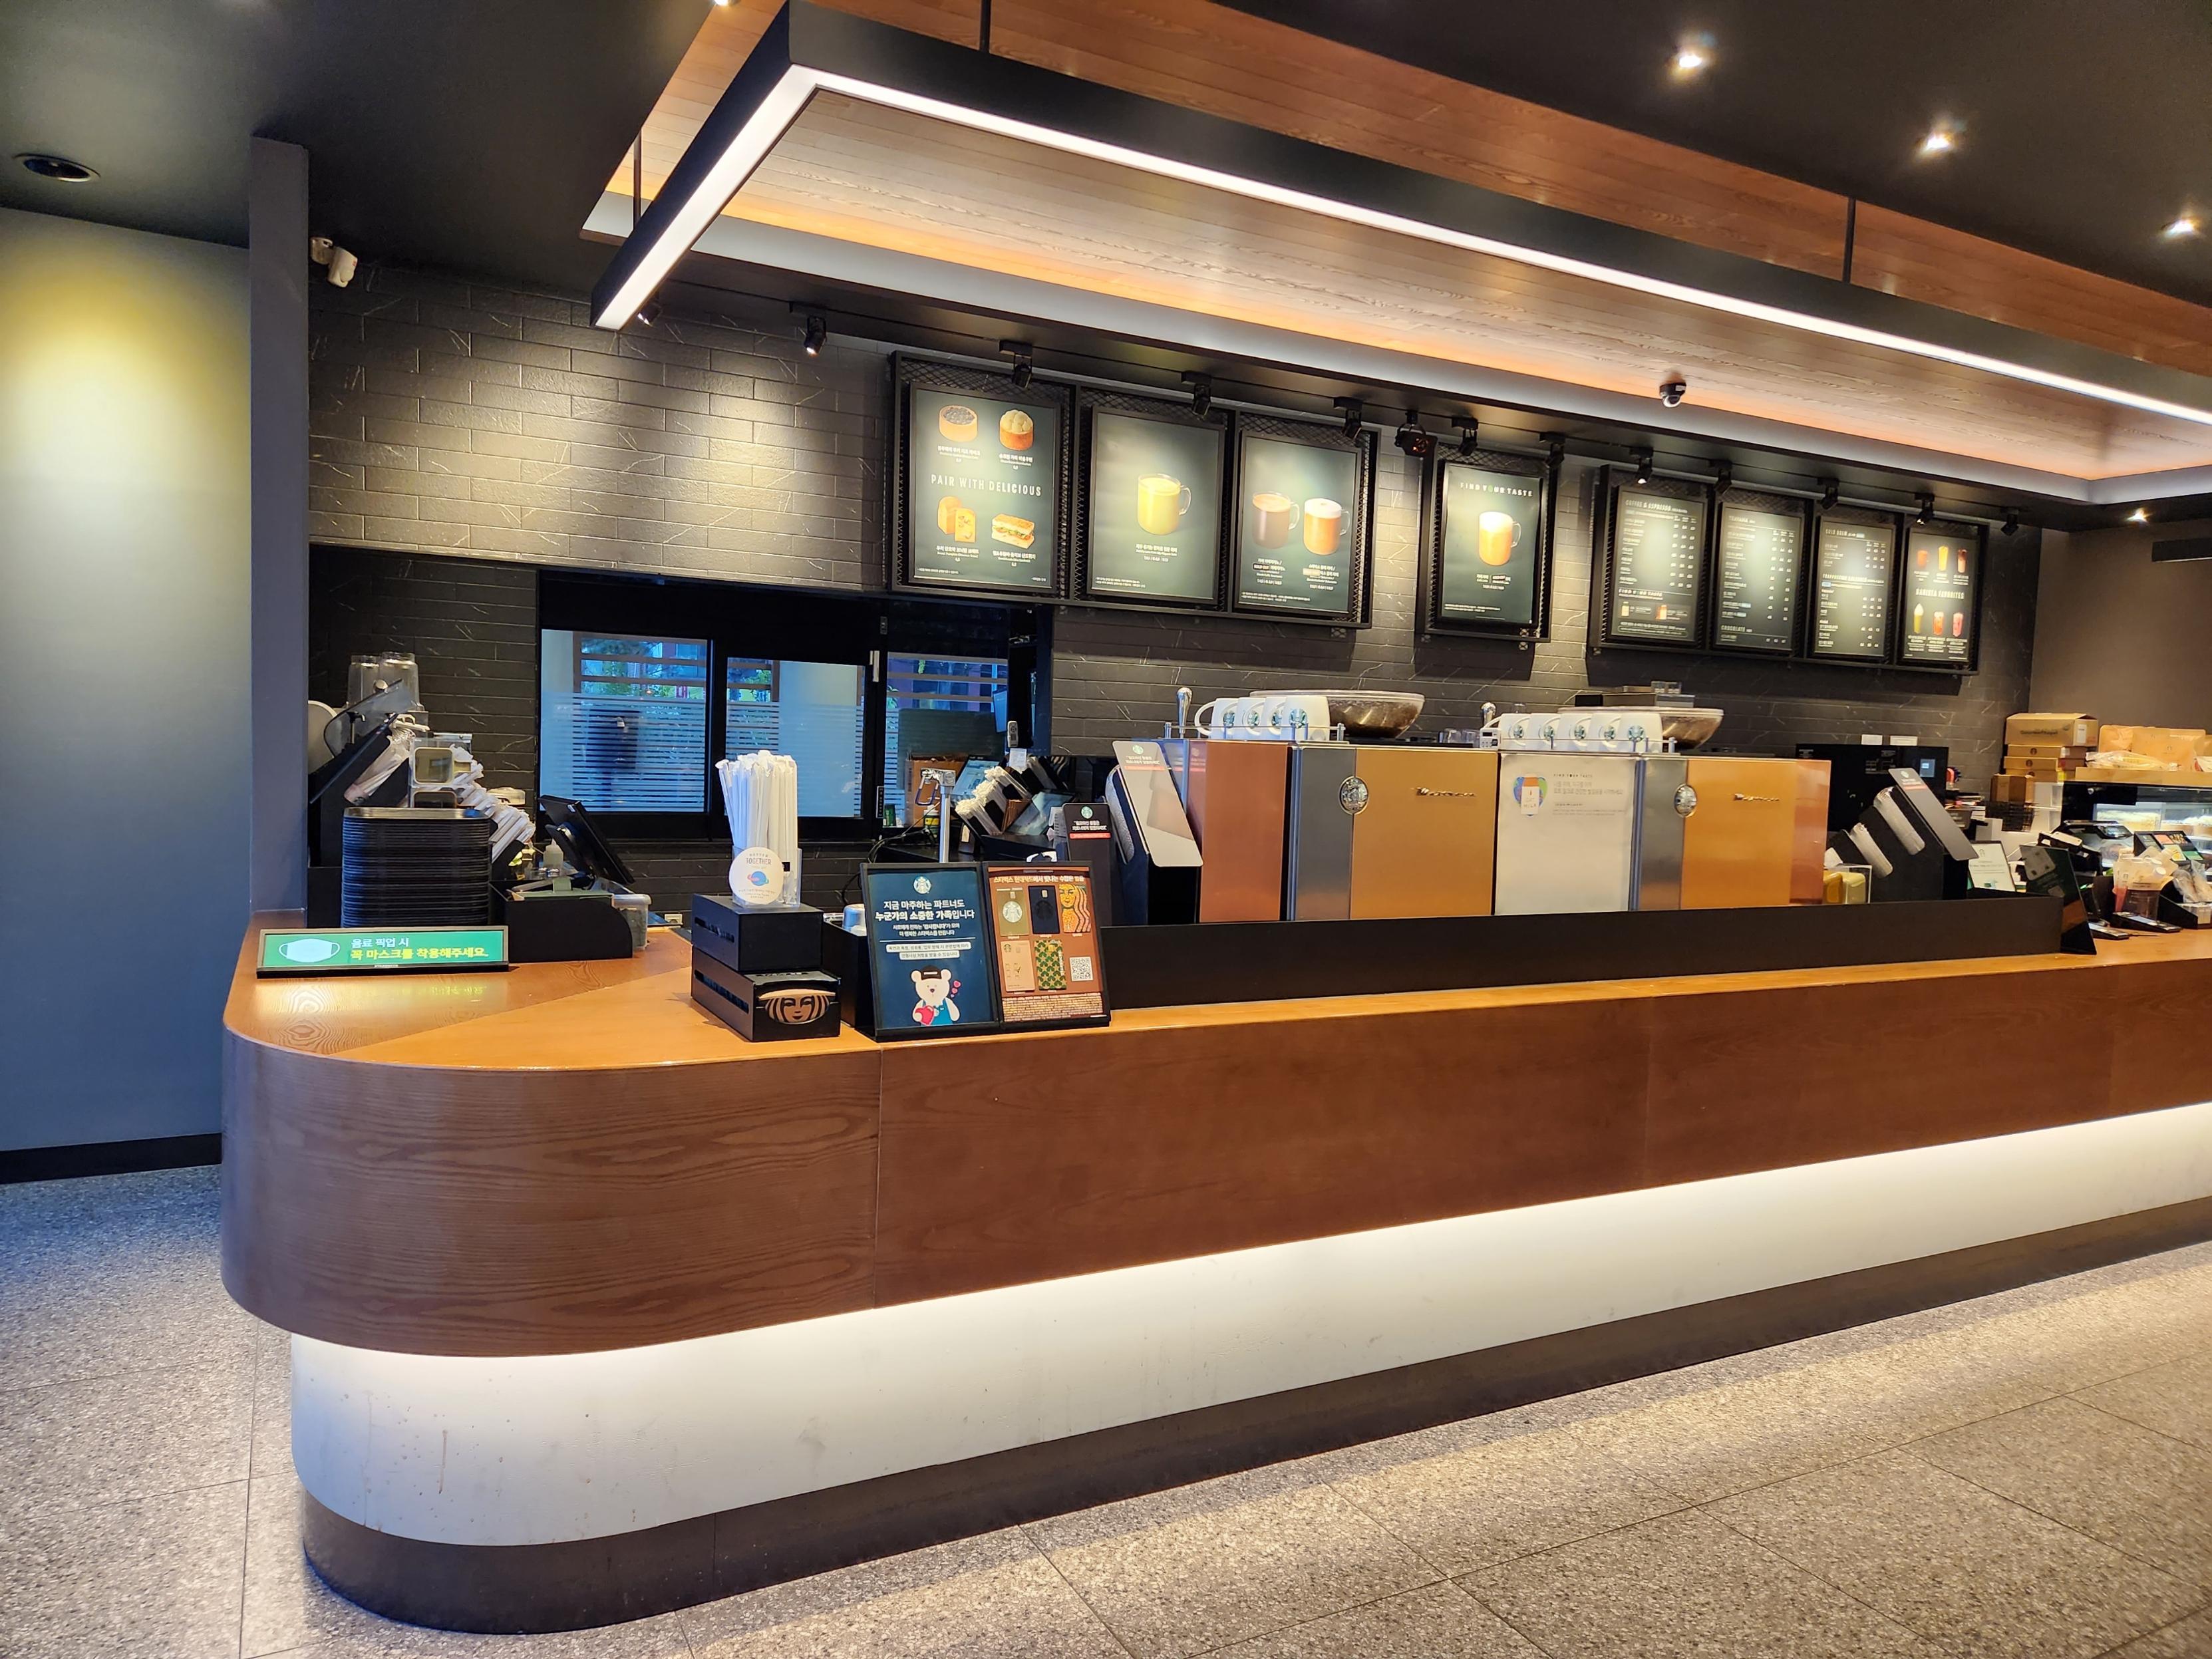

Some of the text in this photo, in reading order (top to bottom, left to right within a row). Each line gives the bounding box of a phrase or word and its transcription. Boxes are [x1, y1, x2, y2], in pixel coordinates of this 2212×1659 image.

[931, 474, 1041, 496] PAIR WITH DELICIOUS
[1483, 485, 1505, 494] YOUR
[1507, 488, 1533, 497] TASTE
[746, 857, 772, 865] TOGETHER
[883, 899, 965, 910] 지금 마주하는 파트너도
[875, 909, 975, 921] 누군가의 소중한 가족입니다
[351, 937, 410, 948] 음료 픽업 시
[350, 947, 489, 961] 꼭 마스크를 착용해주세요.
